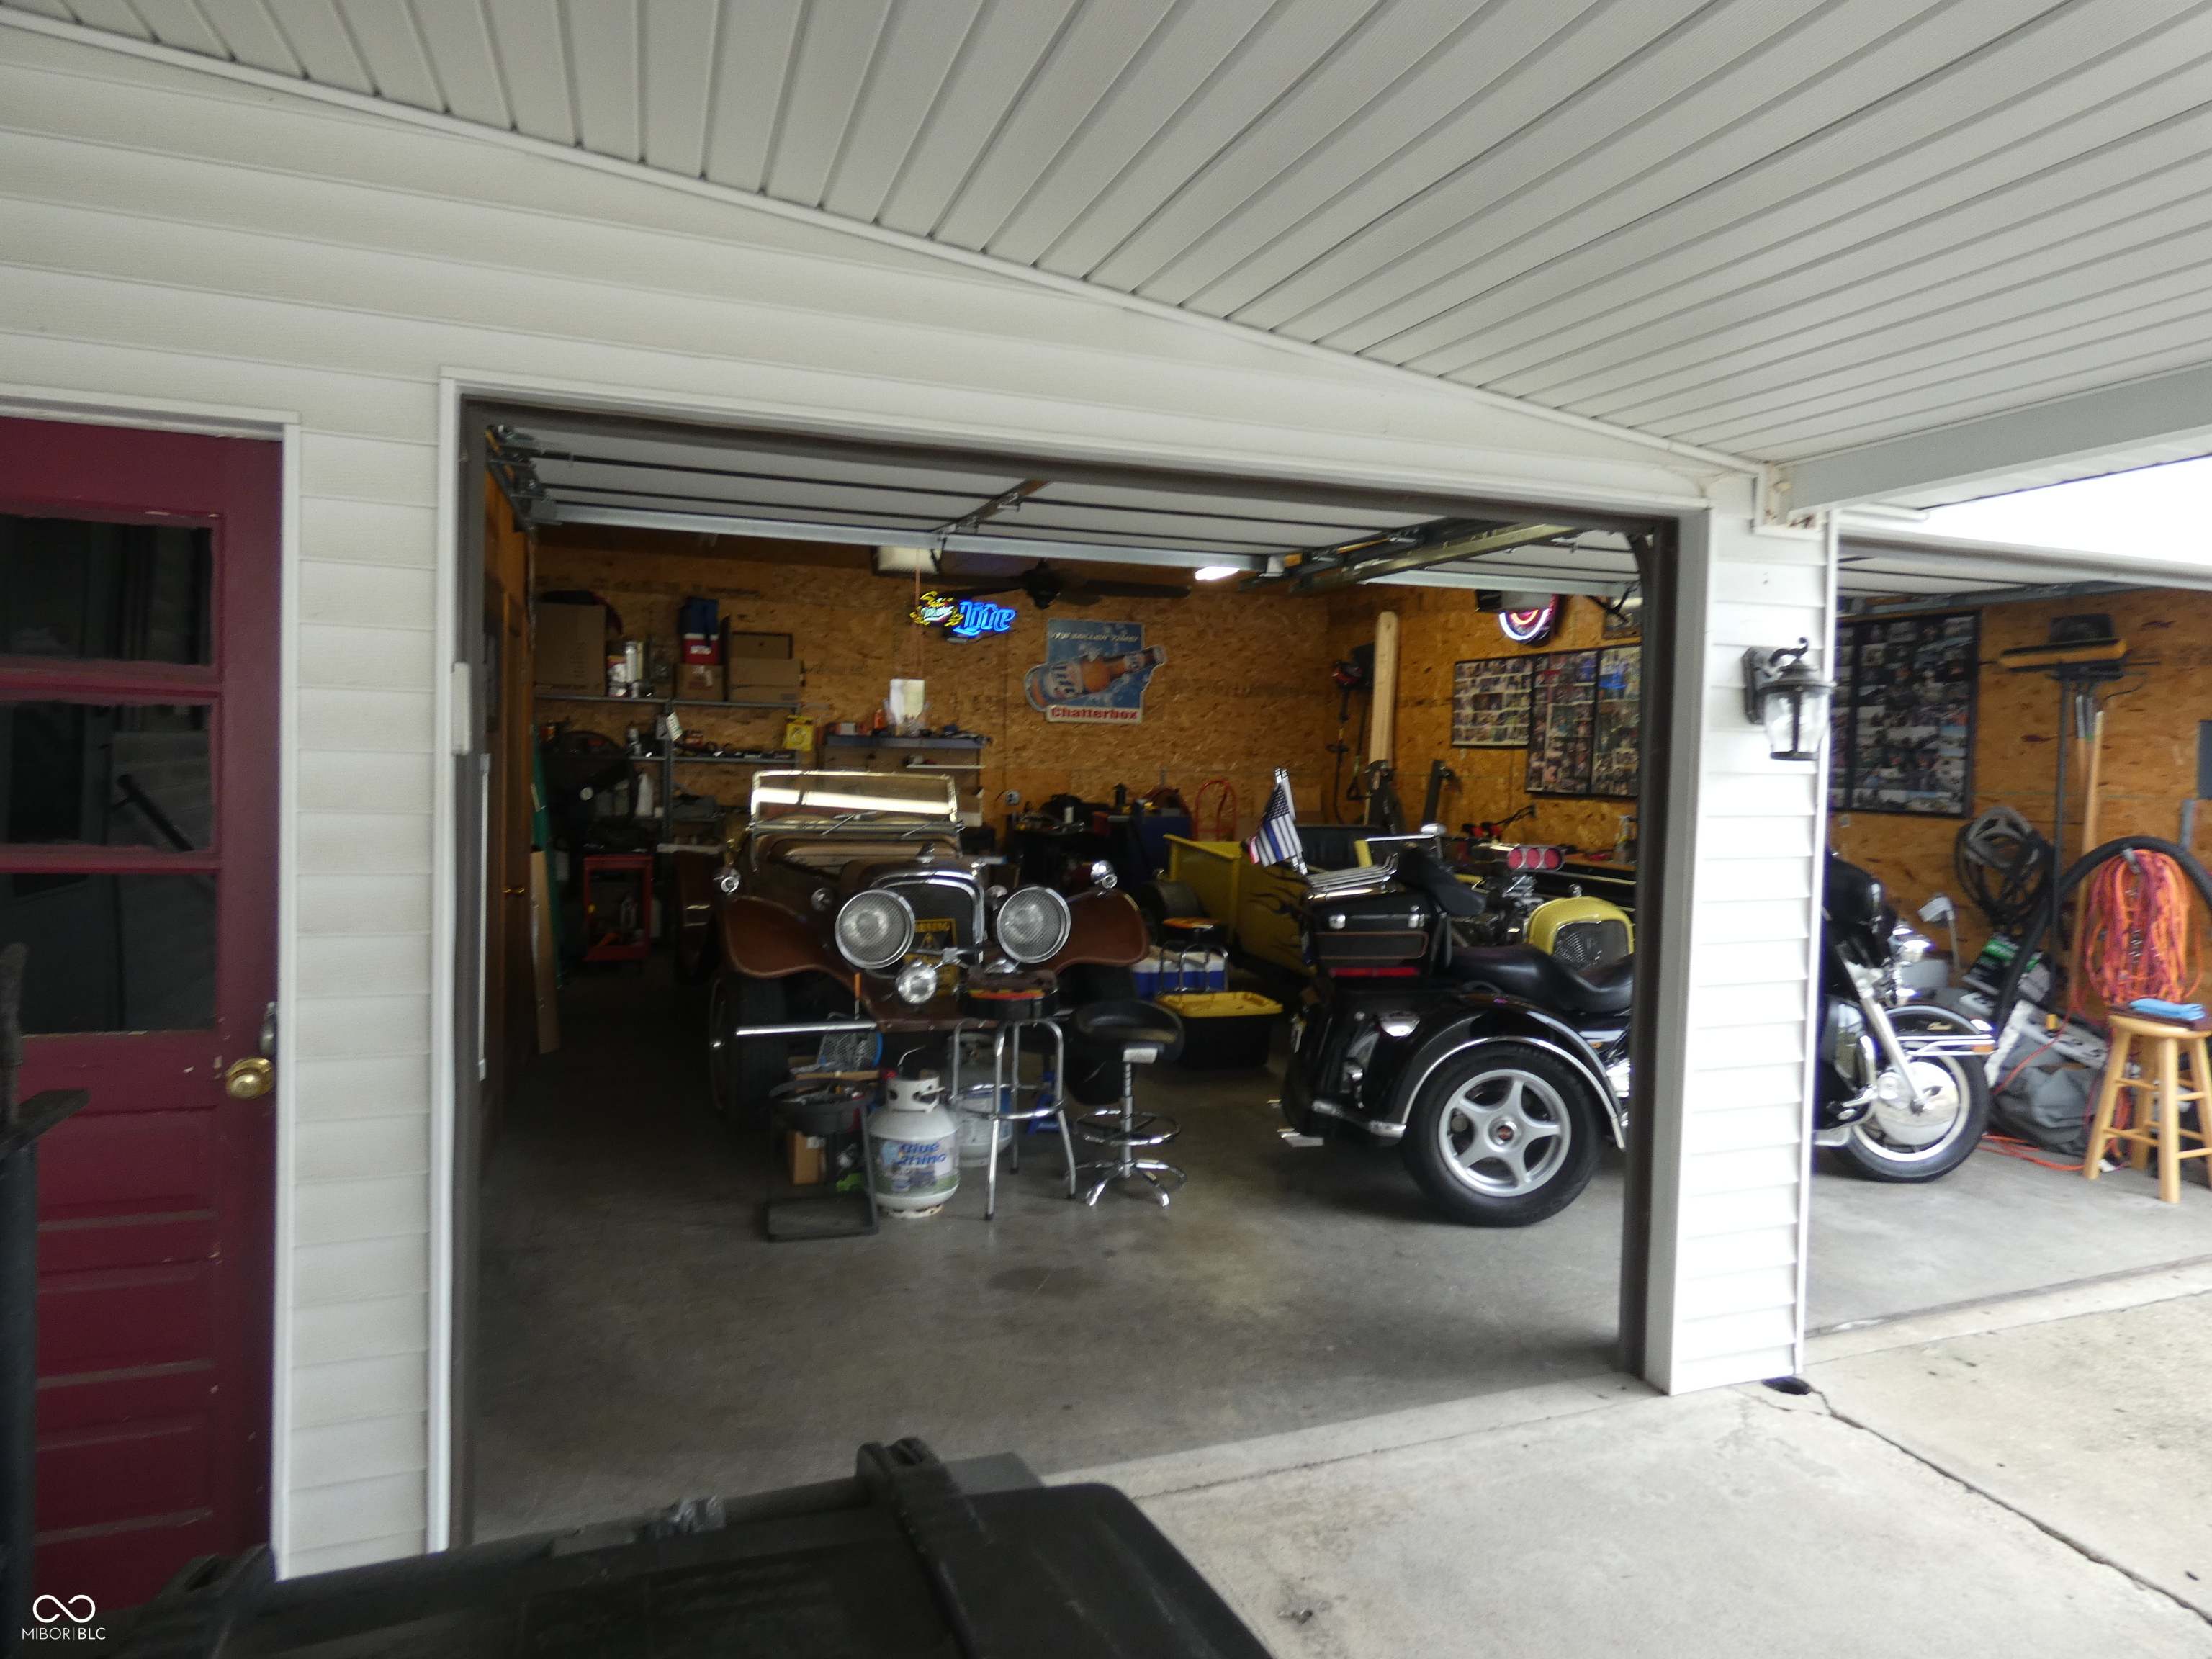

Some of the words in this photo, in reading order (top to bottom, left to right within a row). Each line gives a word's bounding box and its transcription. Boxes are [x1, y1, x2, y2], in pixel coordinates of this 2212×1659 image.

[953, 601, 1016, 636] Lite
[1051, 706, 1138, 720] Chatterbox
[901, 1143, 940, 1154] Blue
[896, 1153, 948, 1165] Rhino
